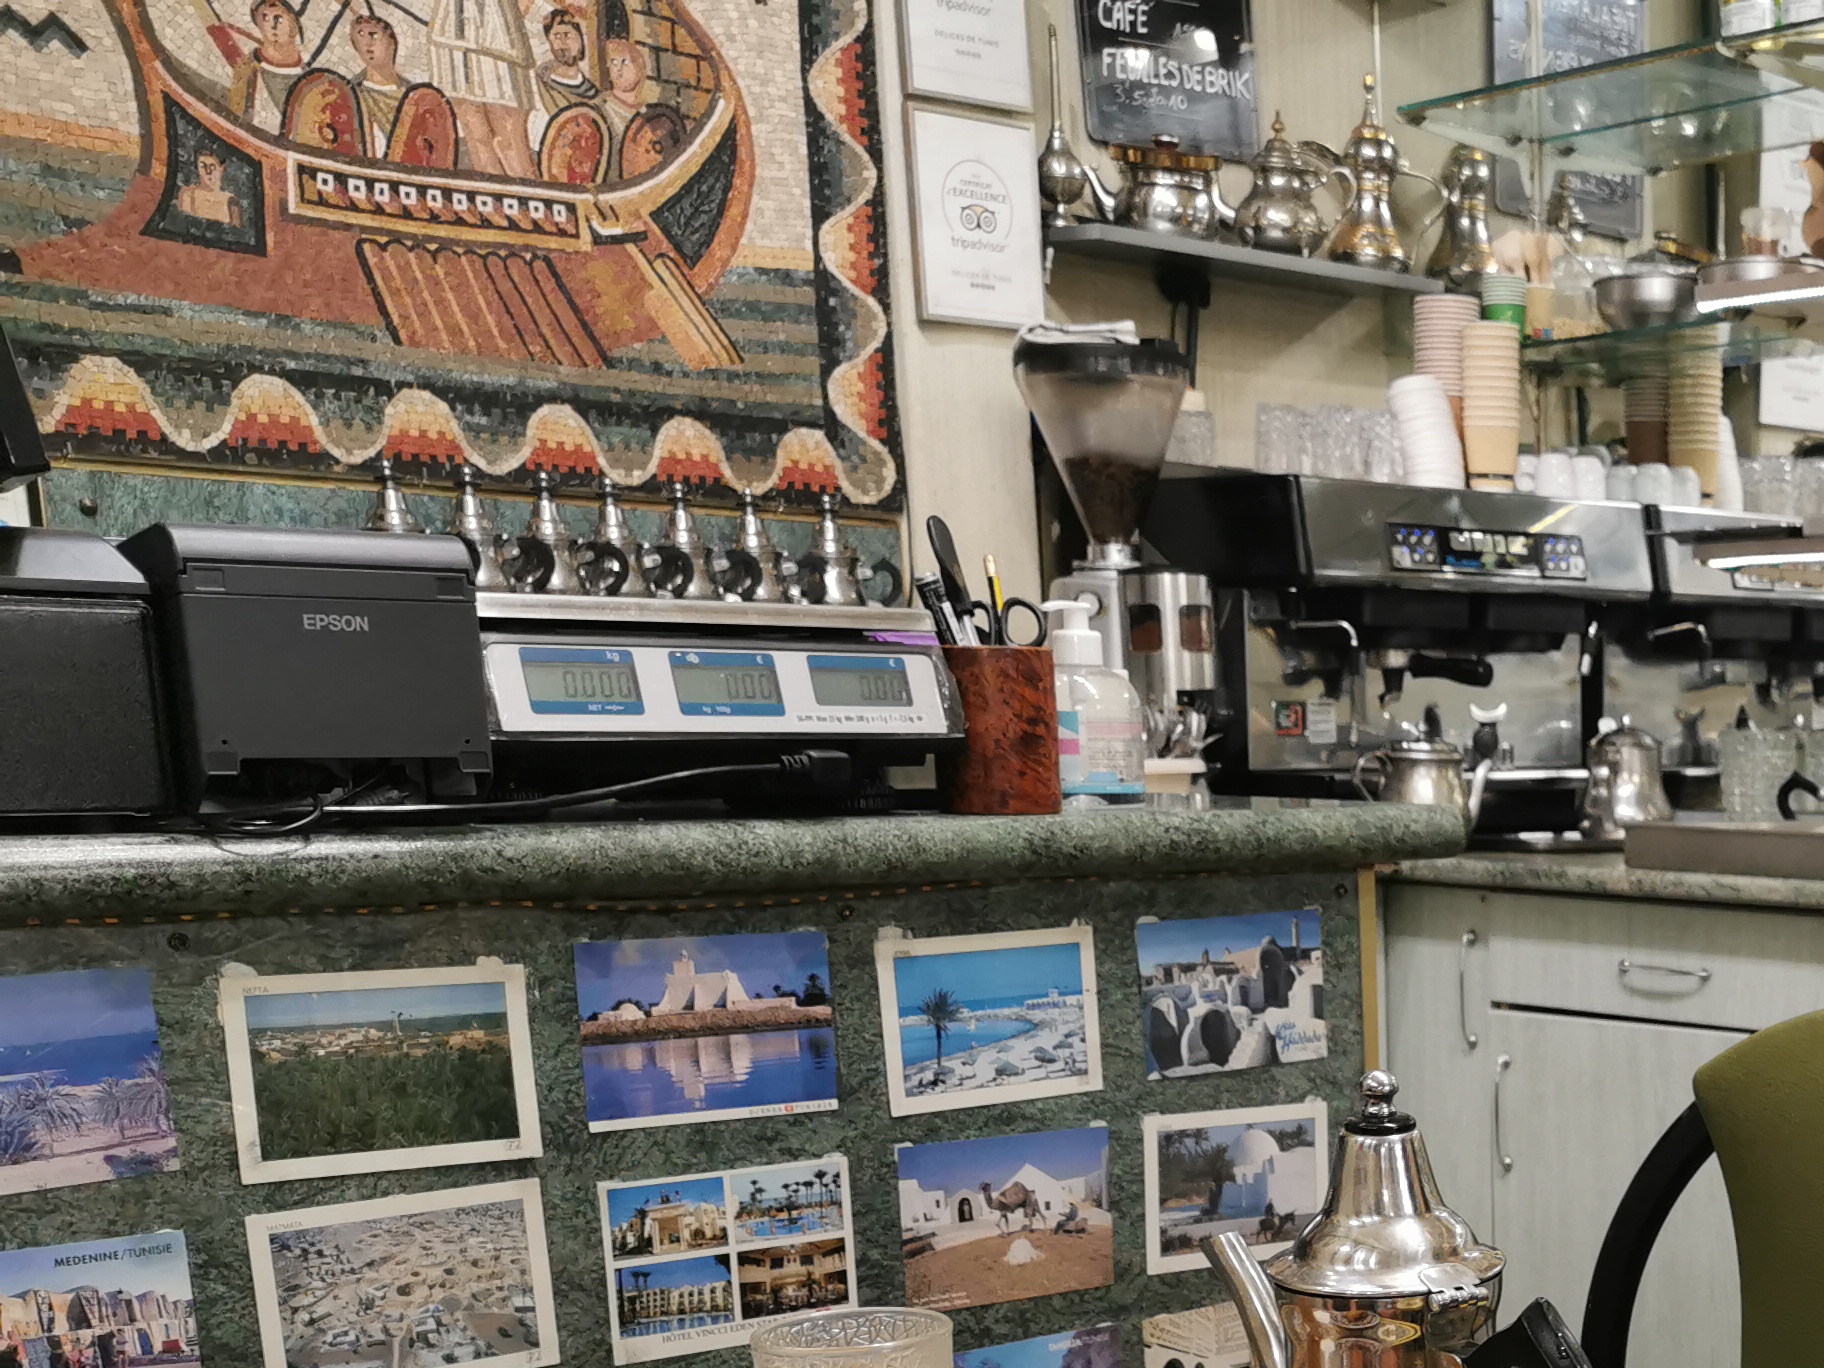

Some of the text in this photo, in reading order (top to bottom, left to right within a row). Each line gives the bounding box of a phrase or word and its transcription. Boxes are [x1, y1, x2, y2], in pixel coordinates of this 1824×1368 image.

[302, 613, 370, 632] EPSON
[605, 650, 620, 662] kg
[662, 1332, 694, 1344] HÔTEL
